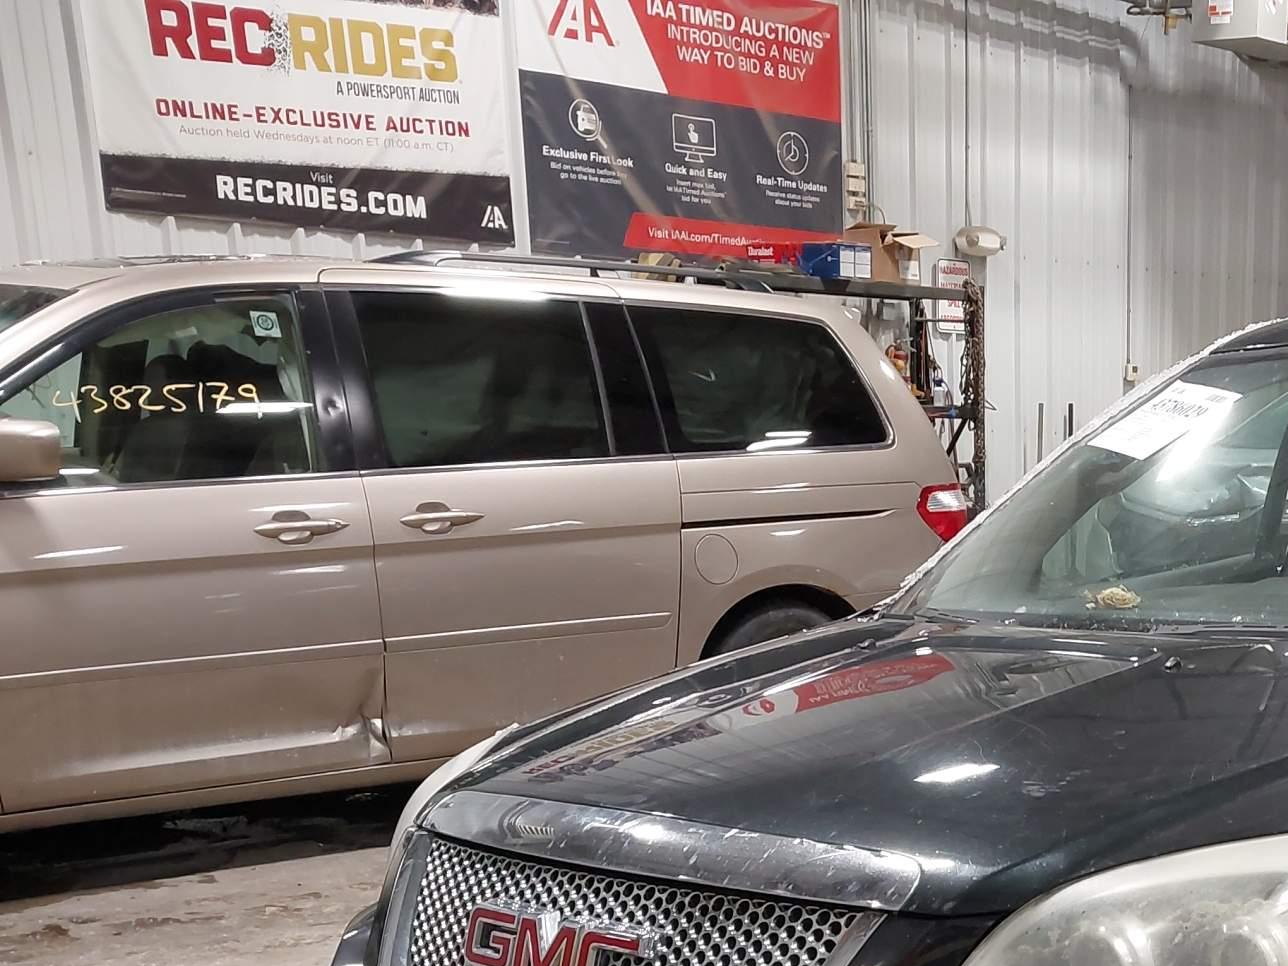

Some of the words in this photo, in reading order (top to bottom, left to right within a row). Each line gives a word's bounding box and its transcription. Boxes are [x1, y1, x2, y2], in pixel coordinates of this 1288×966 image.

[645, 0, 677, 21] IAA
[678, 4, 736, 31] TIMED
[145, 0, 276, 66] REC
[287, 13, 458, 83] RIDES
[667, 24, 766, 57] INTRODUCING
[769, 45, 780, 59] A
[783, 47, 815, 65] NEW
[676, 45, 711, 65] WAY
[714, 51, 735, 69] TO
[738, 56, 760, 74] BID
[763, 61, 775, 77] &
[778, 64, 806, 82] BUY
[336, 81, 344, 96] A
[346, 81, 416, 101] POWERSPORT
[419, 87, 460, 104] AUCTION
[155, 98, 376, 131] ONLINE-EXCLUSIVE
[385, 116, 471, 138] AUCTION
[179, 124, 223, 137] Auction
[226, 127, 251, 139] held
[253, 129, 320, 145] Wednesdays
[323, 133, 333, 145] at
[336, 136, 364, 146] noon
[366, 137, 379, 147] ET
[542, 145, 588, 161] Exclusive
[590, 152, 610, 164] First
[611, 155, 634, 168] Look
[310, 170, 333, 185] Visit
[665, 162, 688, 175] Quick
[689, 167, 705, 177] and
[707, 168, 727, 182] Easy
[756, 174, 797, 189] Real-Time
[798, 180, 828, 193] Updates
[215, 174, 428, 219] RECRIDES.COM
[648, 226, 669, 239] Visit
[52, 382, 263, 423] 43825179
